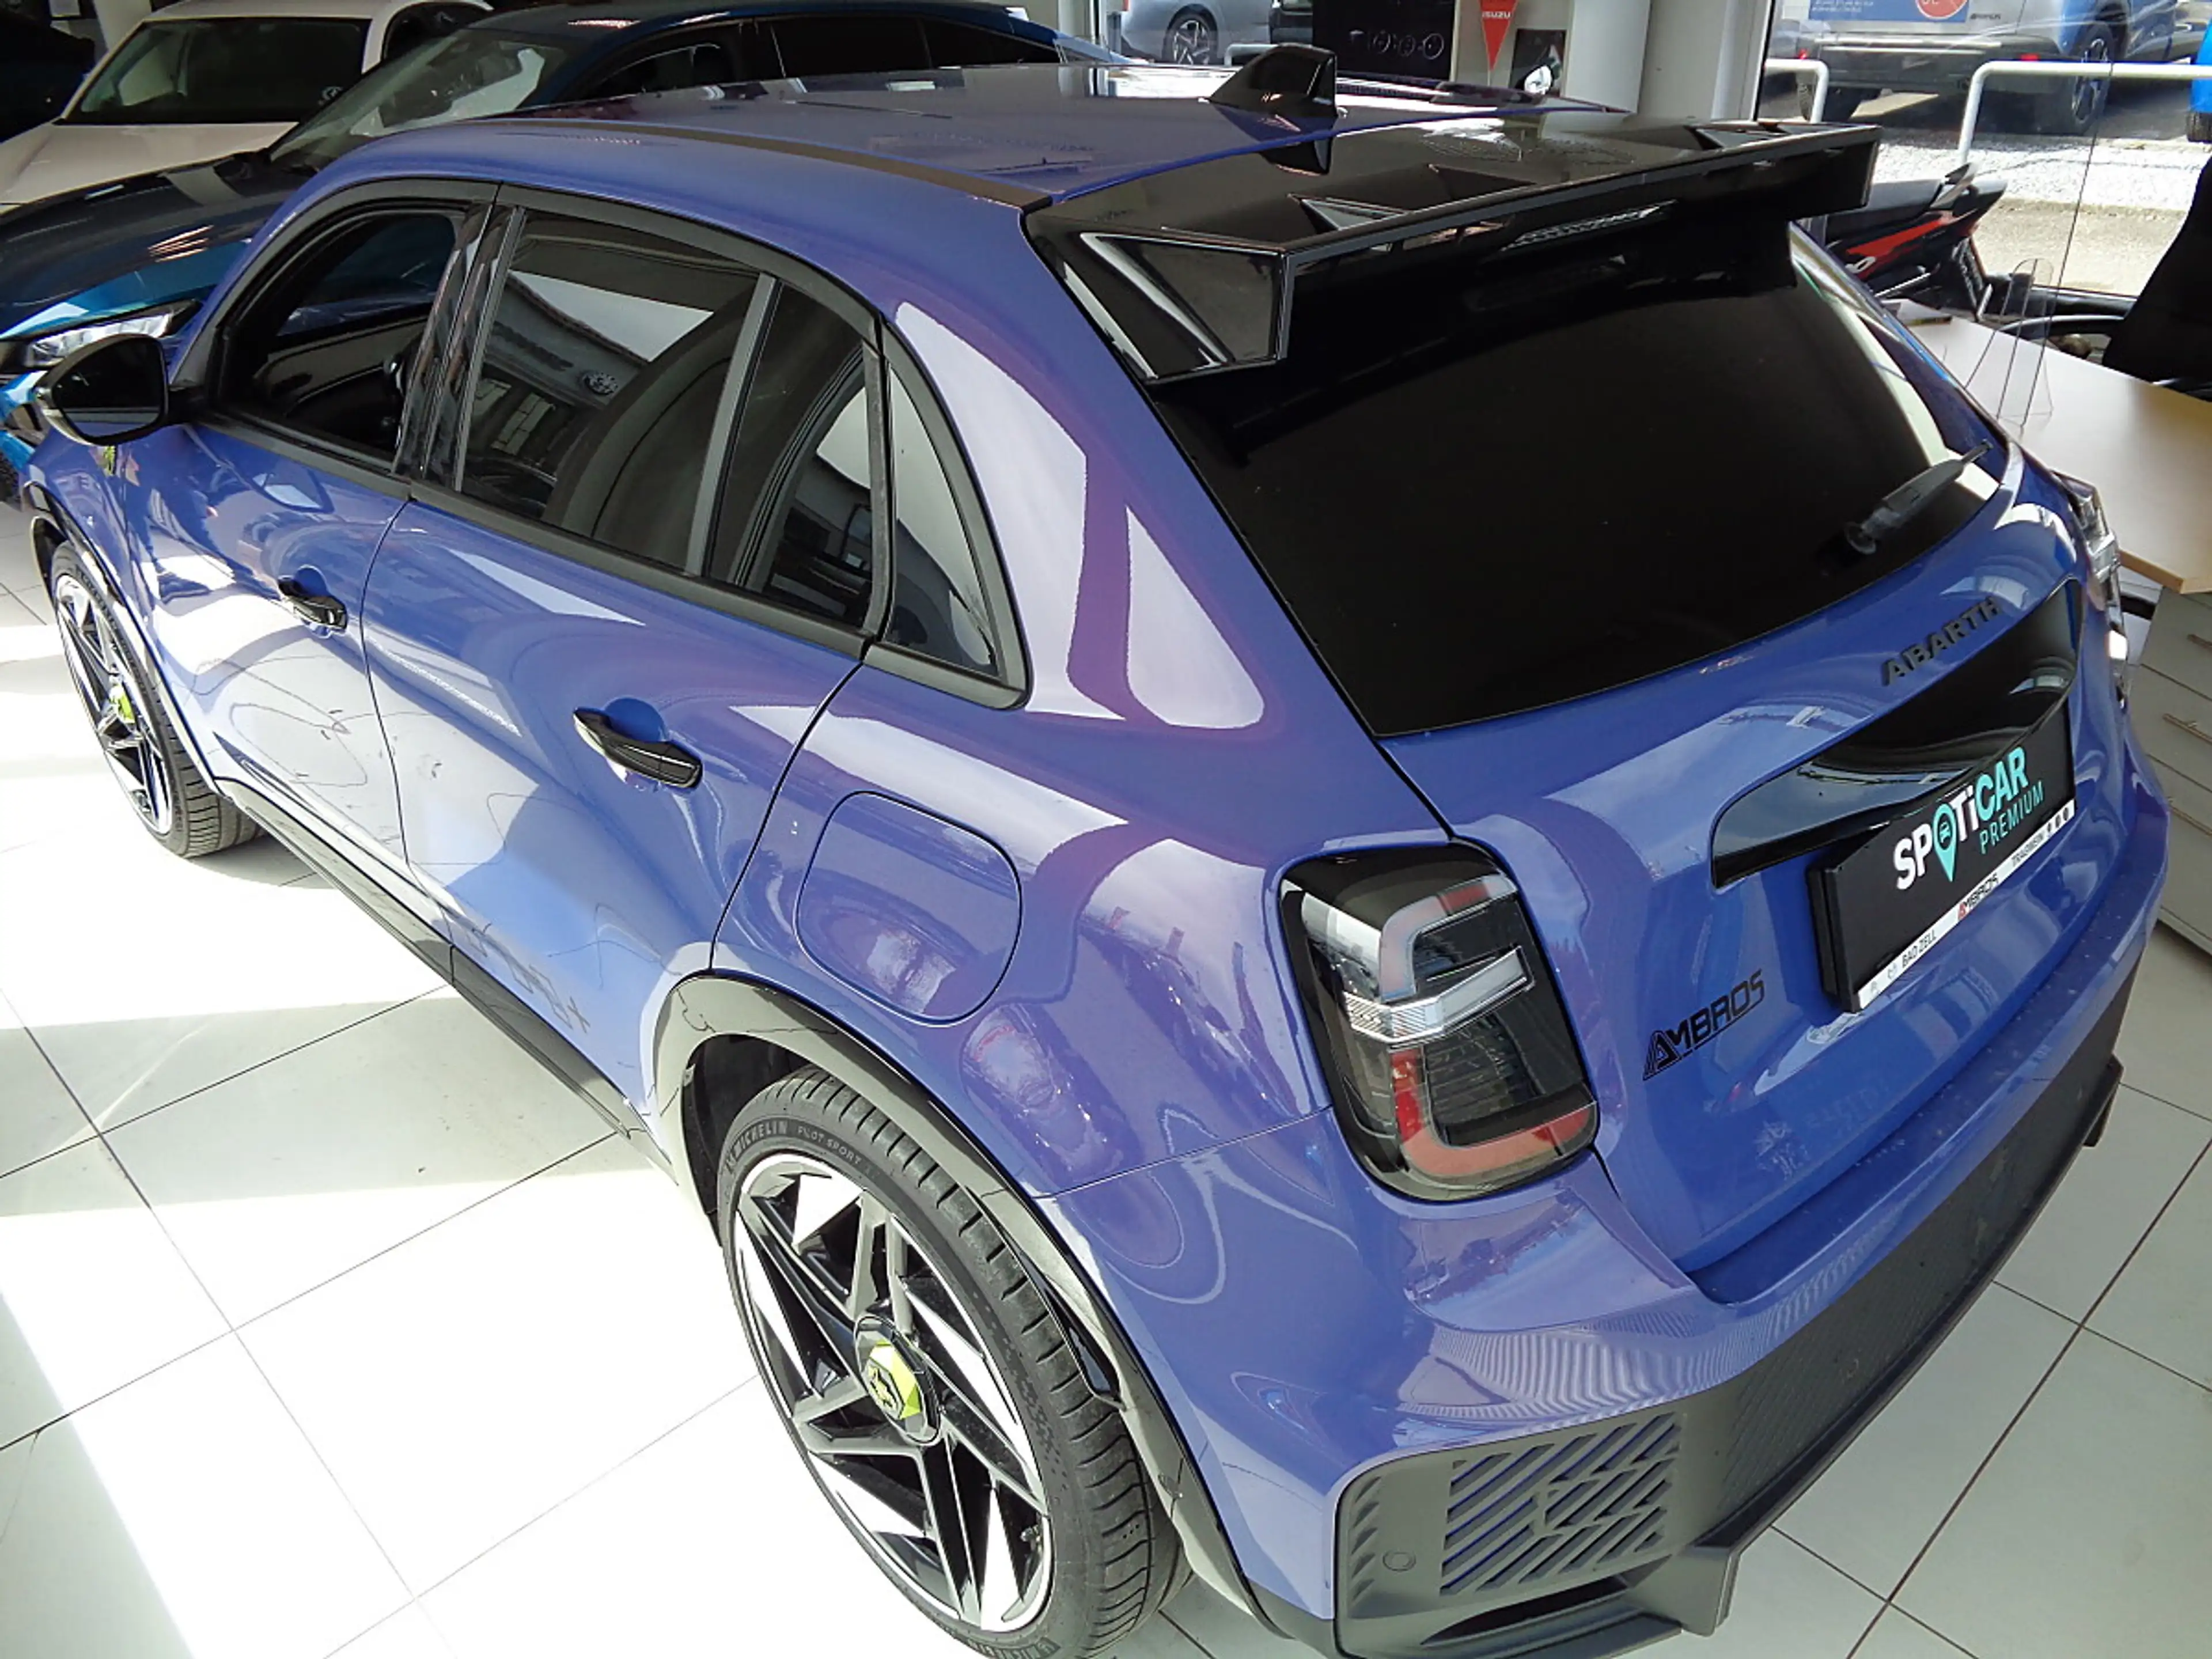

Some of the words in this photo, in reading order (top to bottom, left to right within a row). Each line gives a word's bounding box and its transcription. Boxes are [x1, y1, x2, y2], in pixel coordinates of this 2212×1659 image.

[1881, 596, 2002, 686] ABARTH
[1979, 781, 2043, 854] PREMIUM
[1902, 945, 1918, 968] BAD
[1919, 929, 1936, 953] ZELL
[1642, 968, 1765, 1081] AMBROS
[733, 1120, 789, 1158] MICHELIN
[798, 1126, 825, 1143] PILOT
[827, 1138, 862, 1164] SPORT
